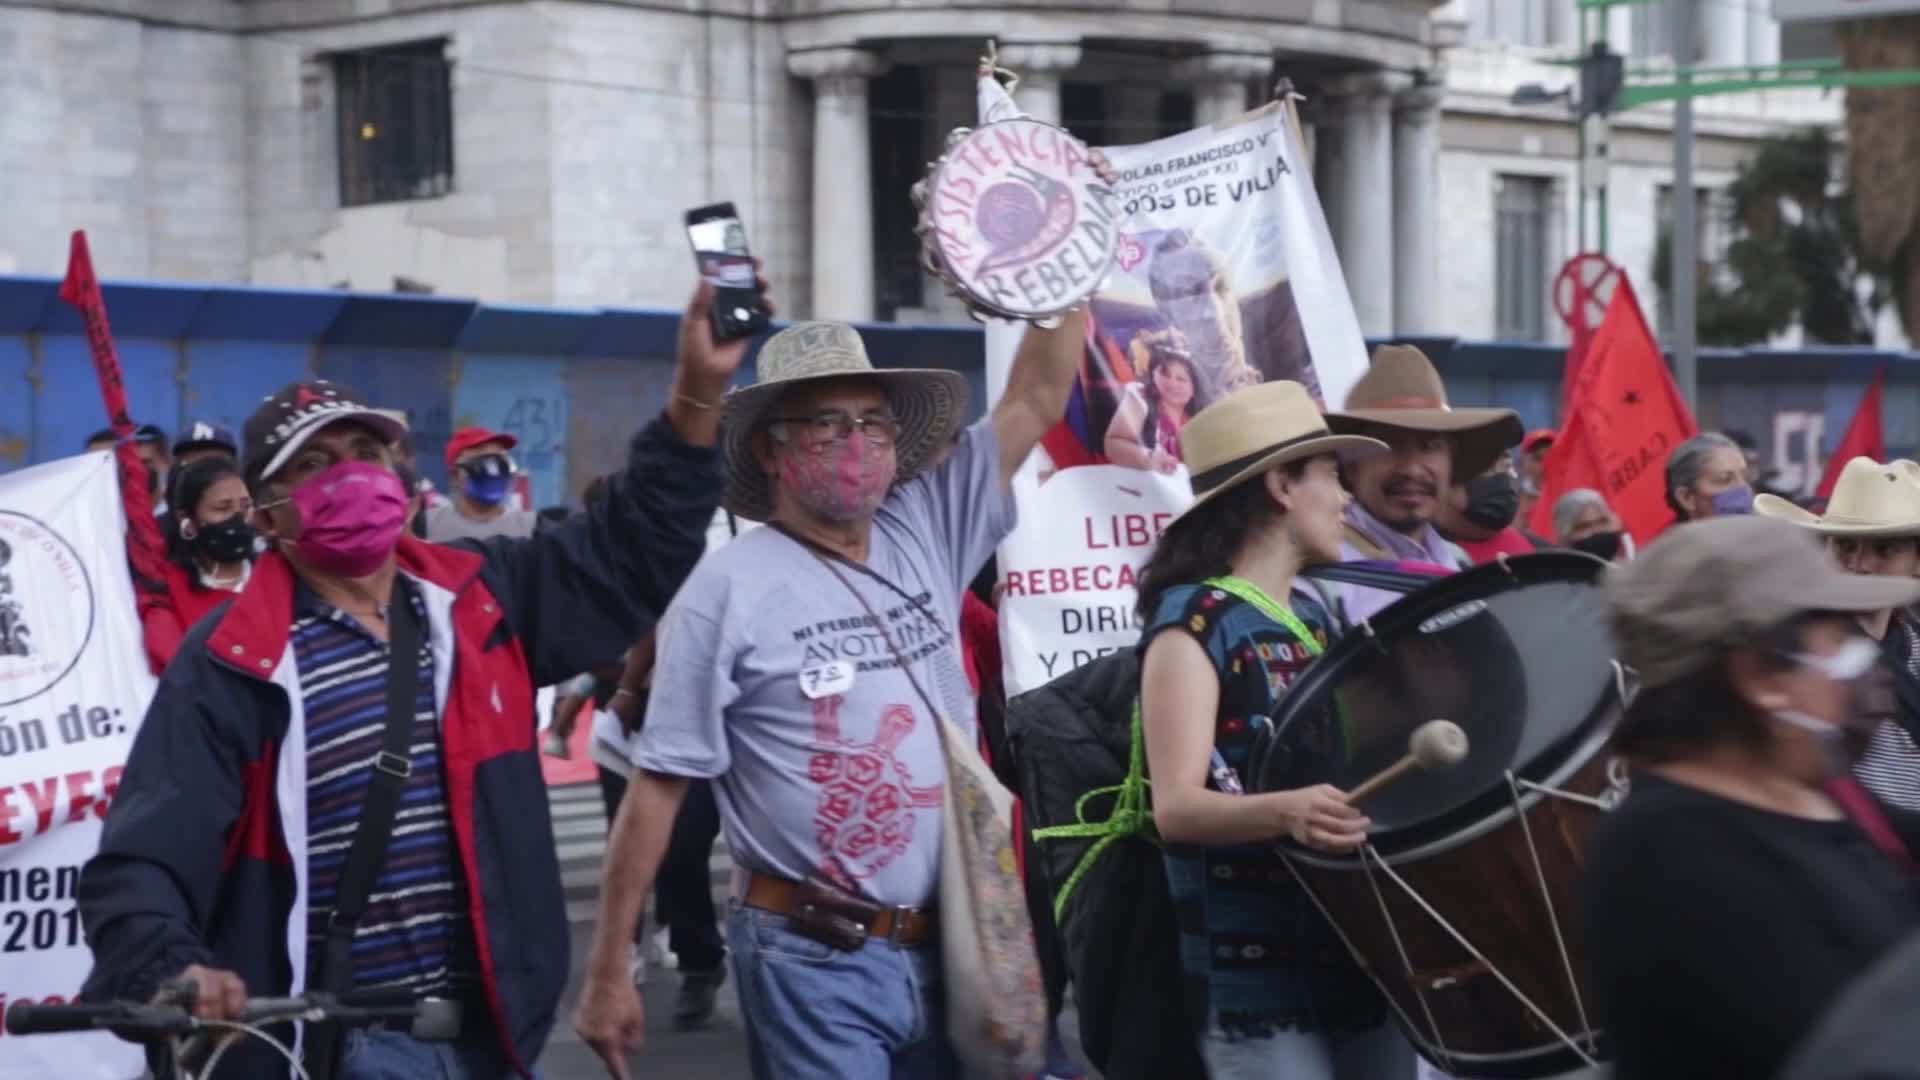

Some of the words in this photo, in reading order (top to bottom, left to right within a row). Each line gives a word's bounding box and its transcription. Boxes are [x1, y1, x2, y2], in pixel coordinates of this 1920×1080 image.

[1167, 138, 1254, 173] FRANCISCO
[1184, 184, 1218, 207] DE
[1007, 563, 1138, 598] REBECA
[1039, 652, 1058, 678] Y
[57, 703, 127, 745] de:
[3, 907, 84, 952] 201
